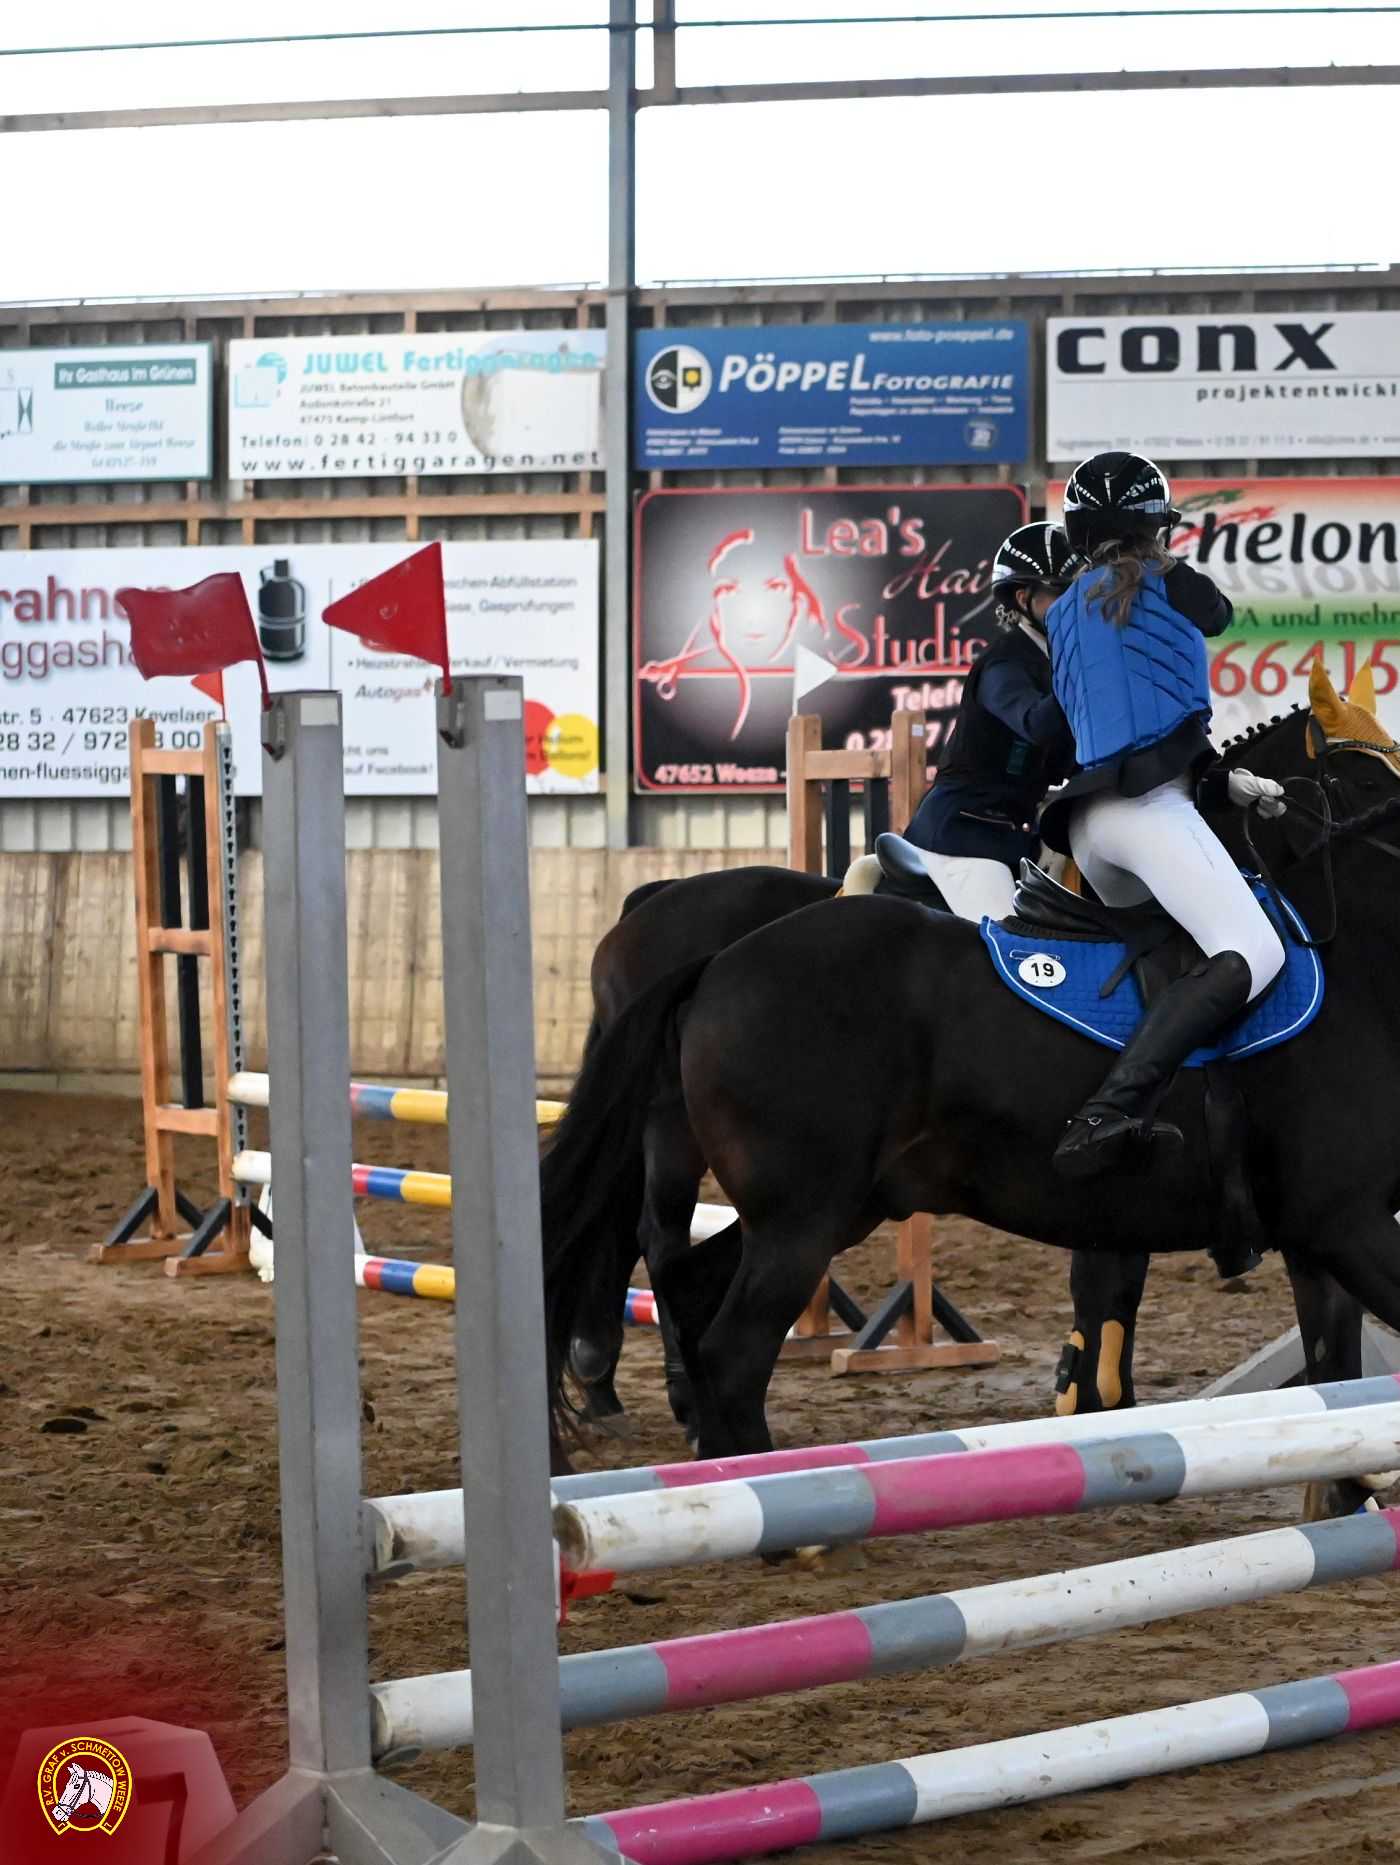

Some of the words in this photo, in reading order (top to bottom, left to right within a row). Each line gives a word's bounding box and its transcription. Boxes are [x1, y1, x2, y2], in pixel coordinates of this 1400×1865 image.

[1056, 322, 1339, 375] conx
[303, 351, 388, 375] JUWEL
[402, 346, 598, 377] Fertiggaragen
[241, 450, 600, 474] www.fertiggaragen.net
[800, 505, 927, 557] Lea's
[882, 538, 994, 601] Hai
[1271, 602, 1321, 627] und
[449, 656, 493, 668] erkauf
[890, 679, 964, 713] Telef
[62, 707, 128, 724] 47623
[27, 731, 56, 751] 32
[84, 730, 128, 751] 972
[171, 730, 202, 750] 00
[1030, 961, 1055, 978] 19
